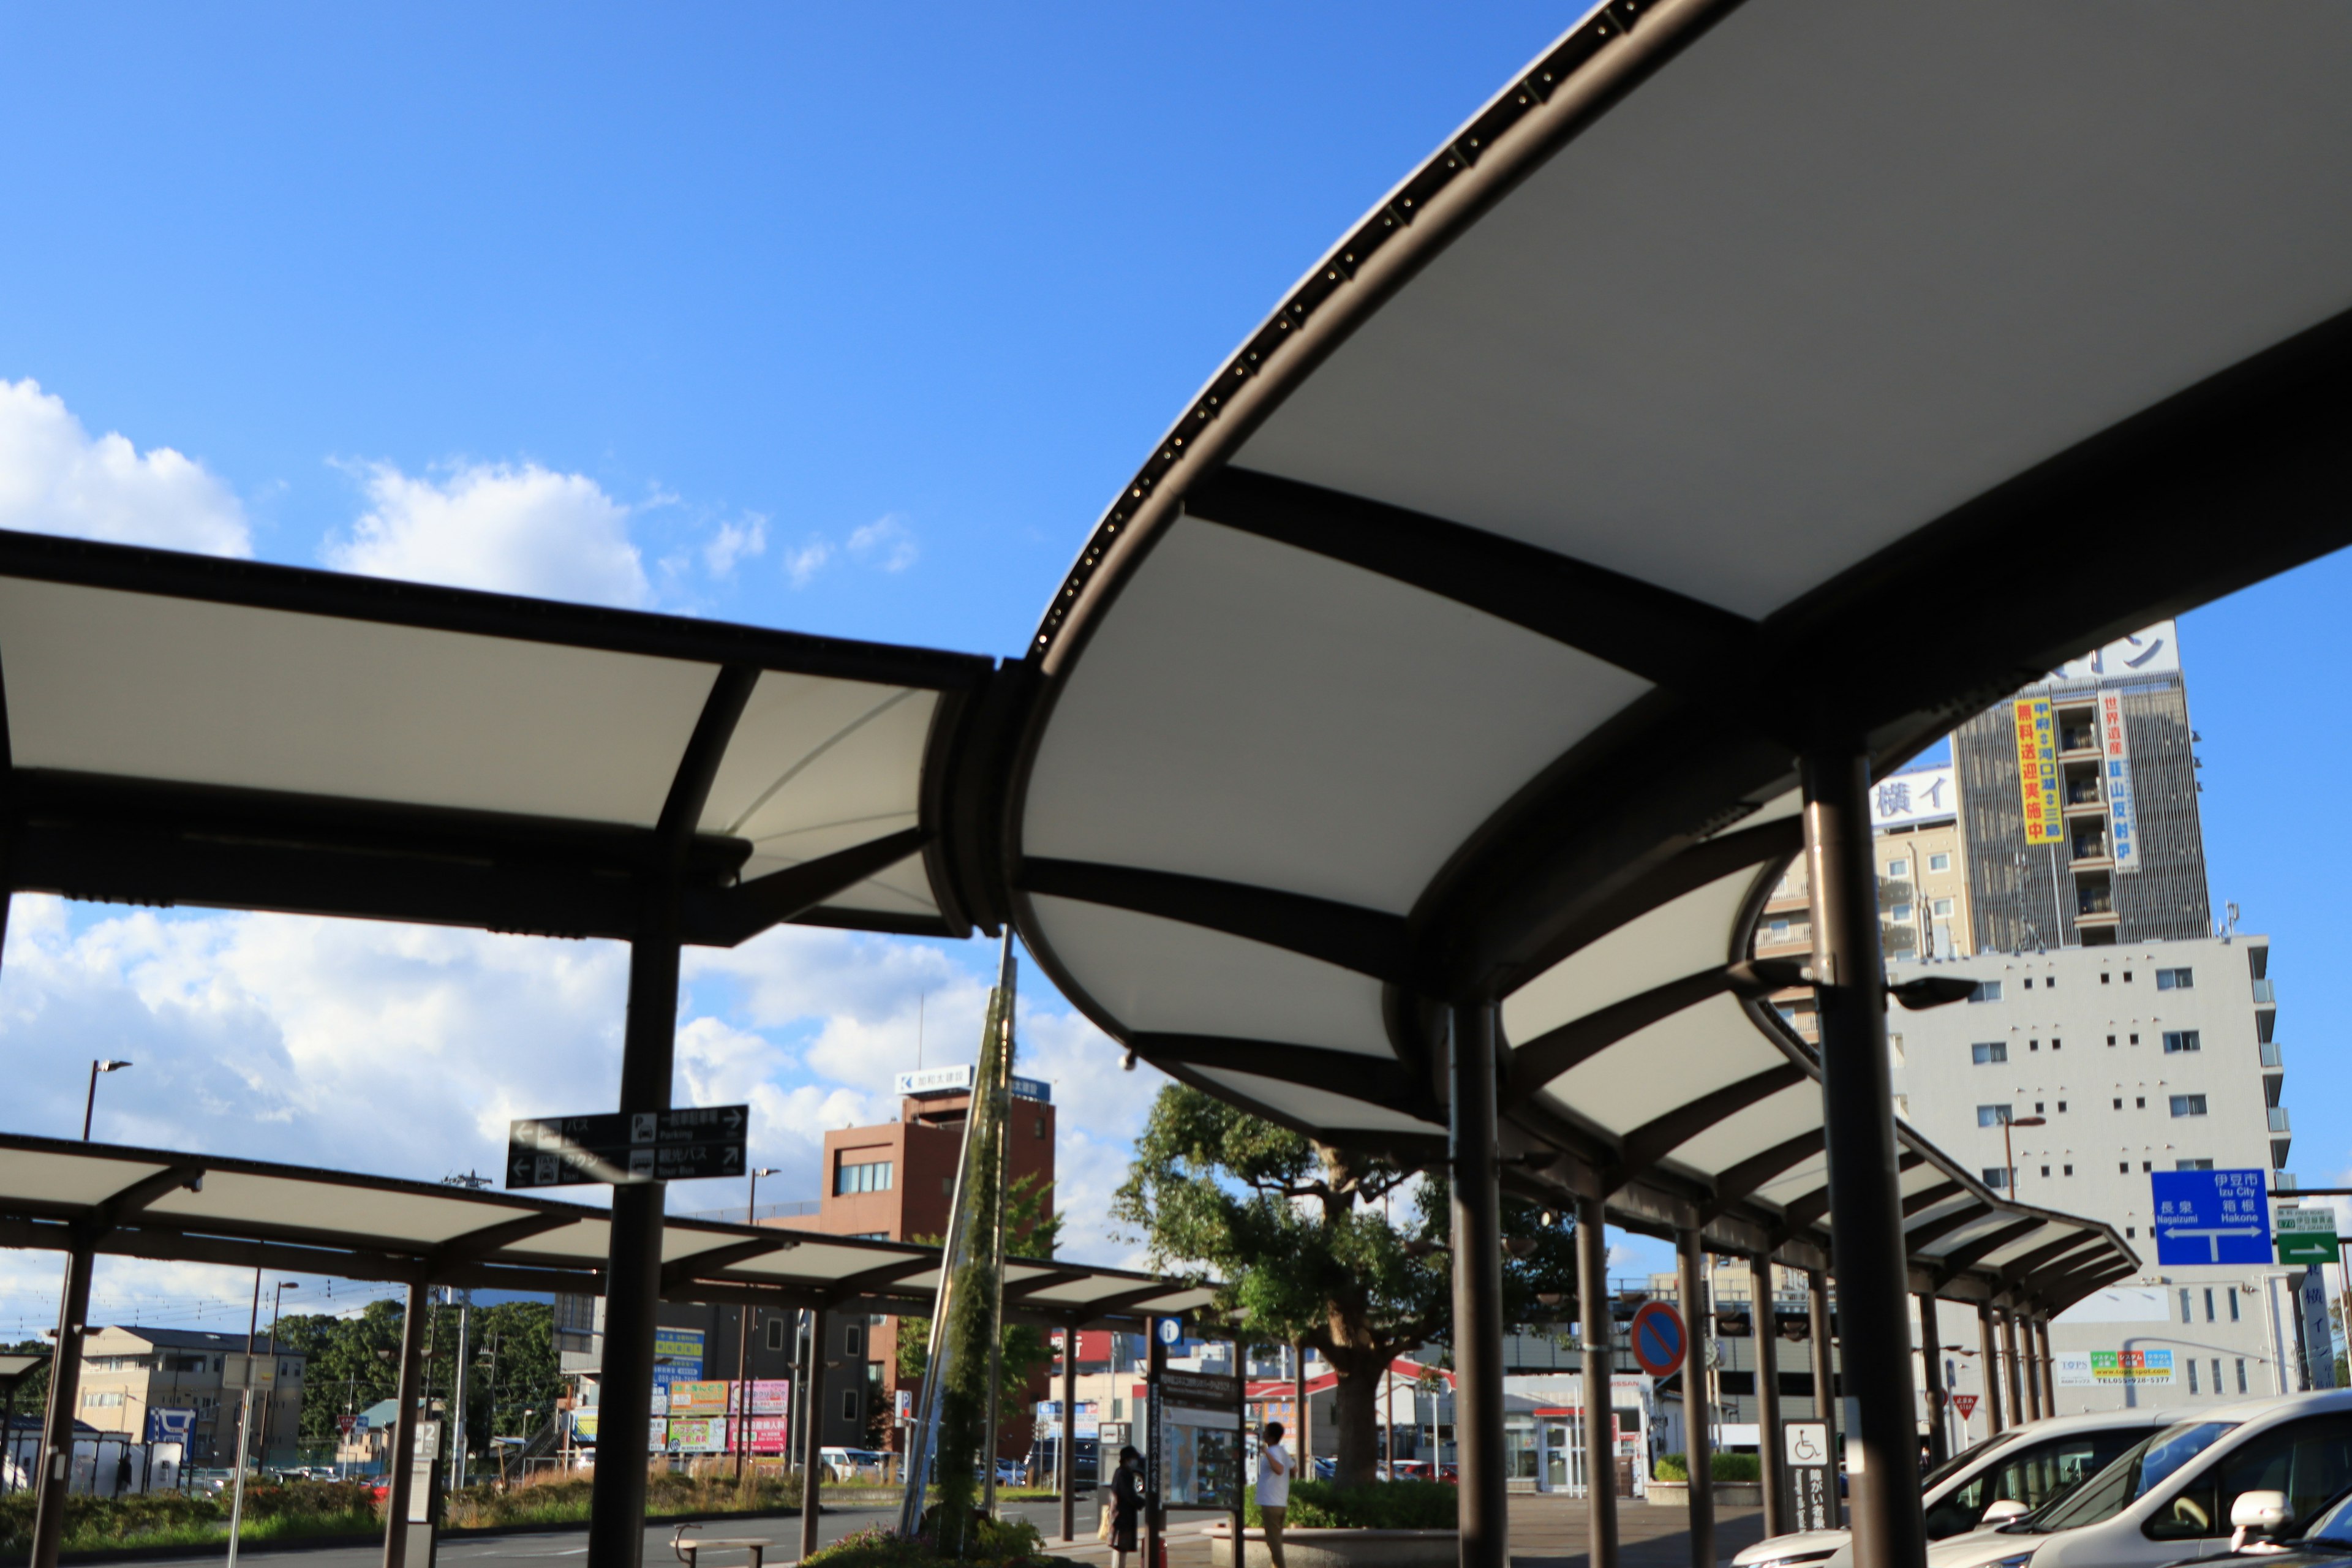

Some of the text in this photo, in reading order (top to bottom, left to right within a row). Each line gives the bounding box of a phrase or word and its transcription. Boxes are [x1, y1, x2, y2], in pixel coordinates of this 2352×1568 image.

[2105, 696, 2123, 755] 世界遺産
[2017, 704, 2043, 839] 無料送迎実施中
[2034, 703, 2060, 837] 甲府 河口湖 三島
[2108, 760, 2130, 859] 韮山反射炉
[918, 1072, 963, 1086] 加和太建設
[1012, 1083, 1038, 1095] 太建設
[567, 1120, 588, 1132] バス
[660, 1130, 693, 1140] Parking
[566, 1155, 609, 1167] タクシー
[658, 1147, 707, 1163] 観光バス
[563, 1172, 579, 1181] Taxi
[658, 1166, 695, 1175] Tour Bus
[2215, 1173, 2258, 1186] 伊豆市
[2219, 1186, 2255, 1197] Izu City
[2162, 1200, 2193, 1213] 長泉
[2222, 1199, 2255, 1213] 箱根
[2157, 1214, 2198, 1224] Nagaizumi
[2222, 1213, 2258, 1223] Hakone
[2062, 1360, 2088, 1370] TOPS
[903, 1393, 909, 1407] P
[425, 1424, 435, 1441] 2
[1809, 1469, 1825, 1531] 障がい者乗
